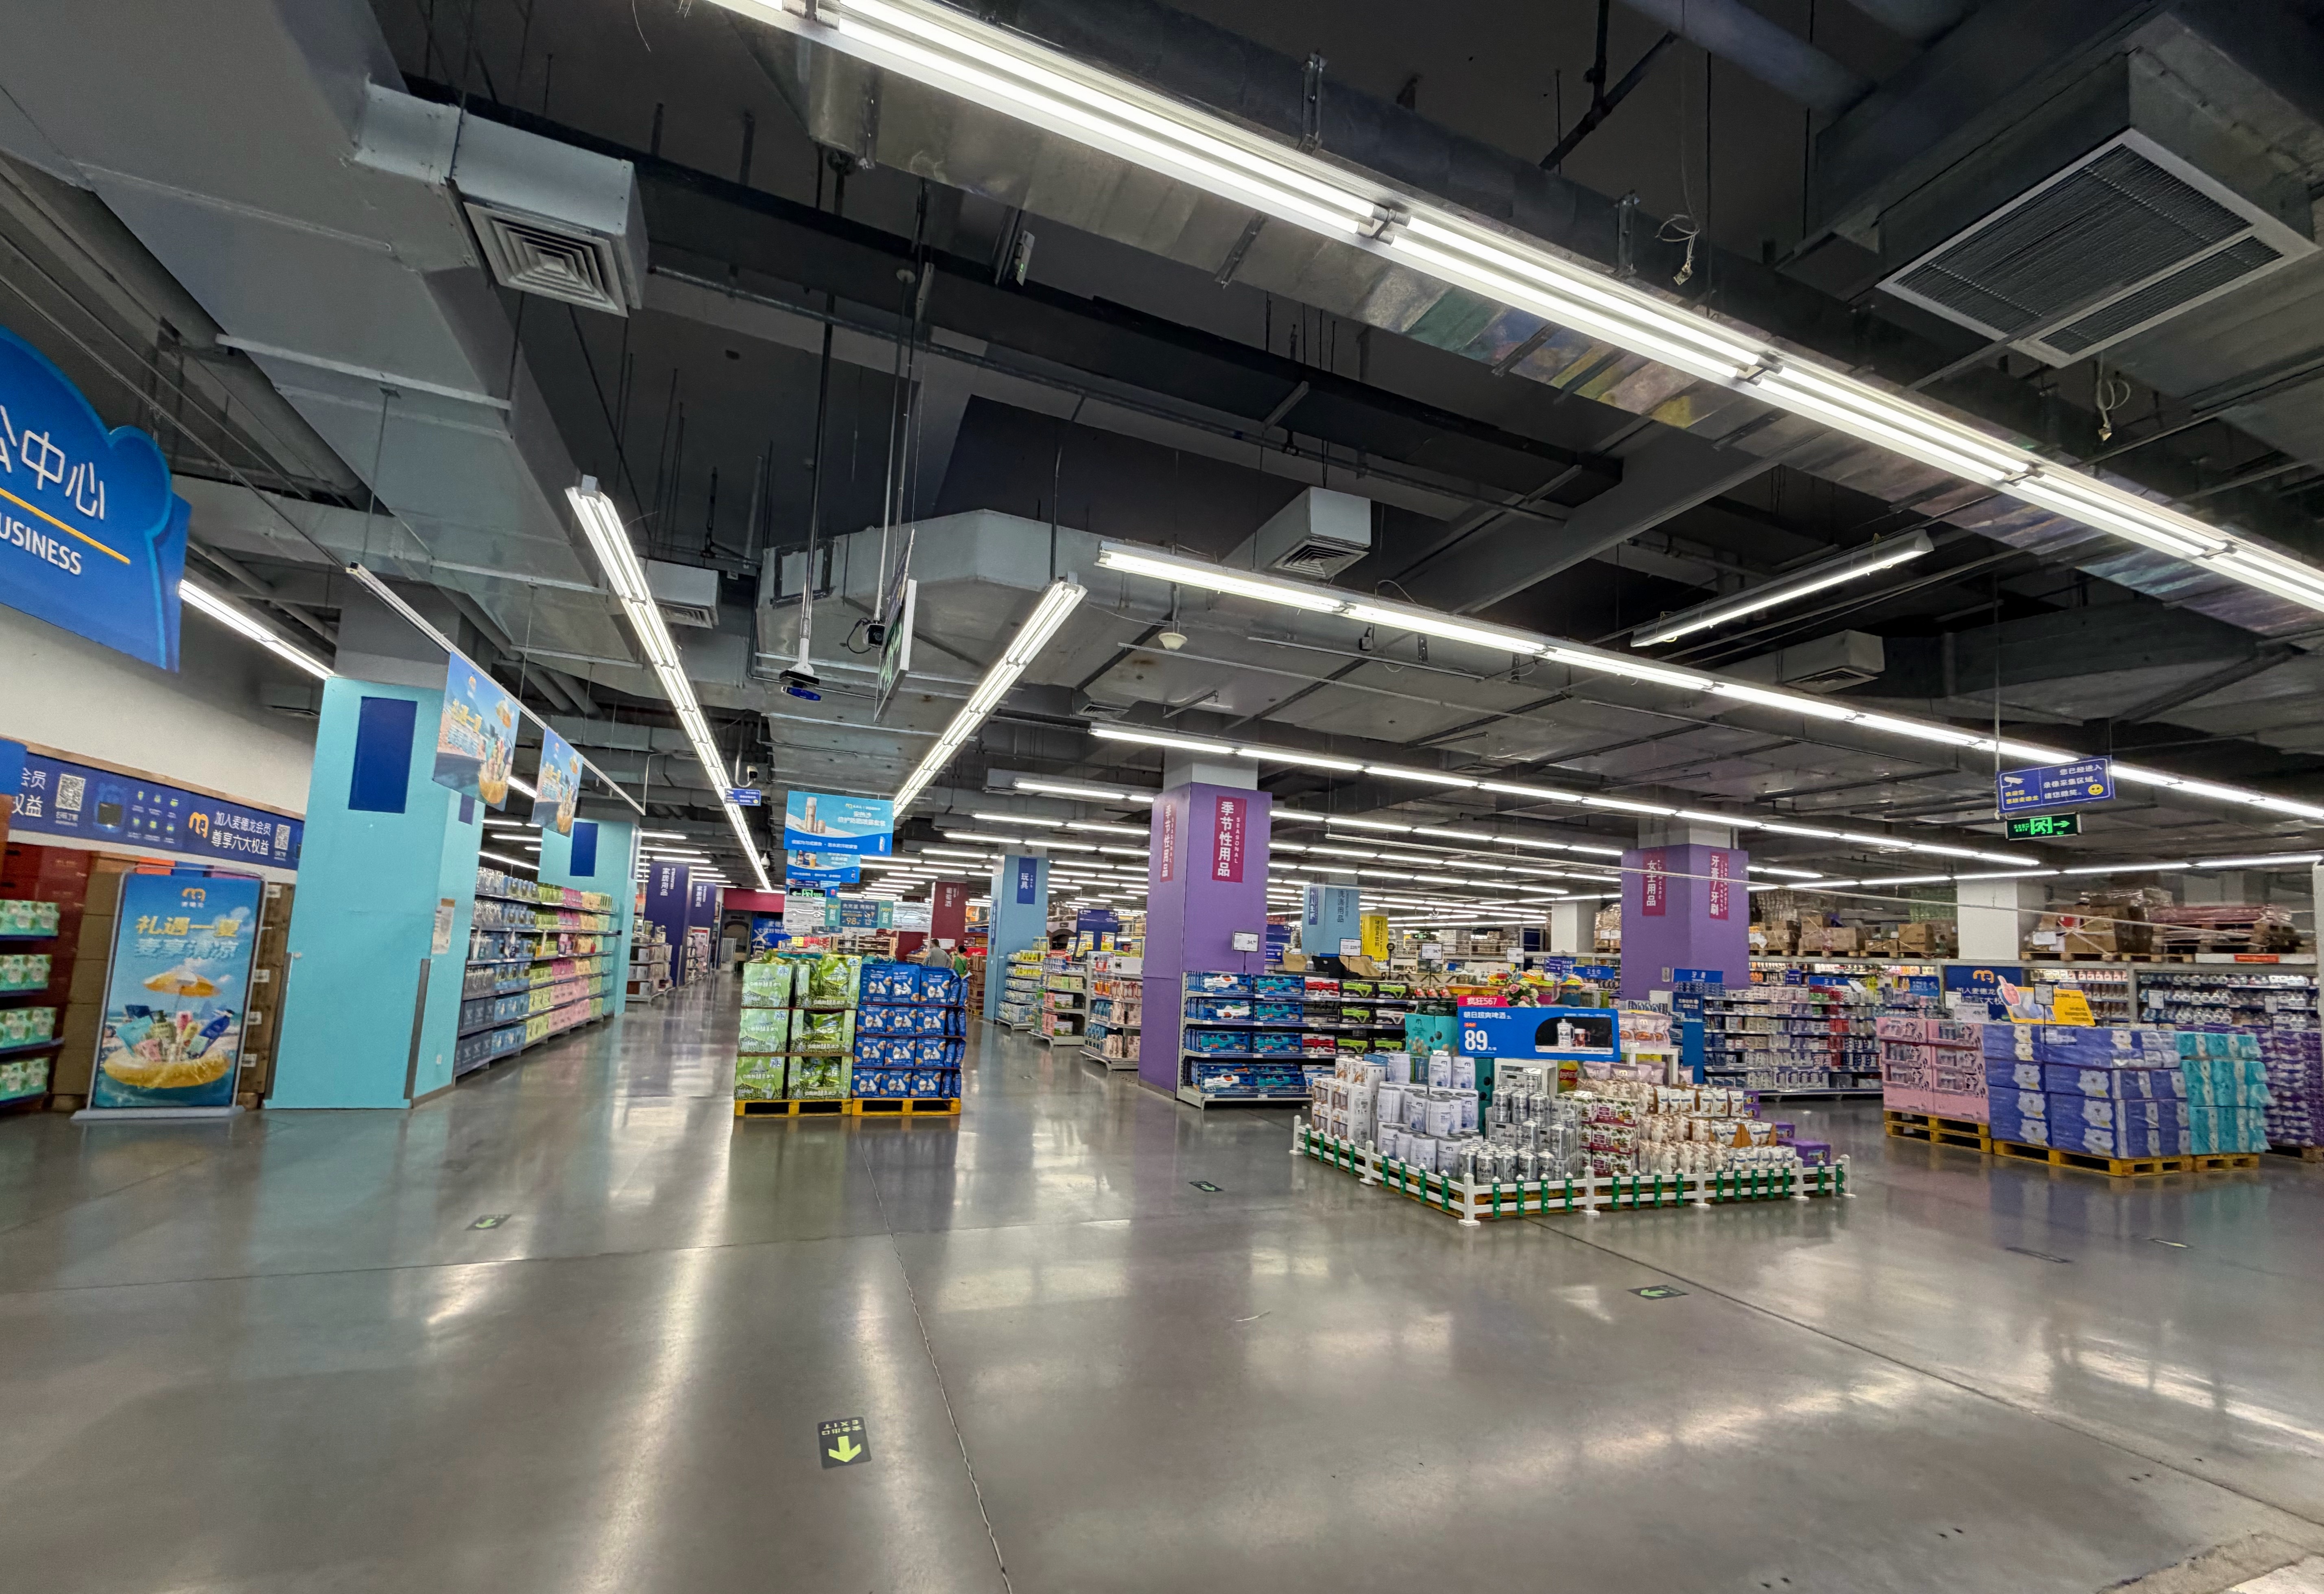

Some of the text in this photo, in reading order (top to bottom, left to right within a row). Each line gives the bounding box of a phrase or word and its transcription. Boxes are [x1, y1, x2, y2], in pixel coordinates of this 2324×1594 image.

[214, 811, 271, 837] 加入麦德龙会员
[211, 830, 269, 855] 尊享六大权益
[1218, 801, 1234, 877] 季节性用品
[1020, 873, 1029, 889] 玩具
[1646, 860, 1657, 906] 女士用品
[1465, 1030, 1488, 1051] 89
